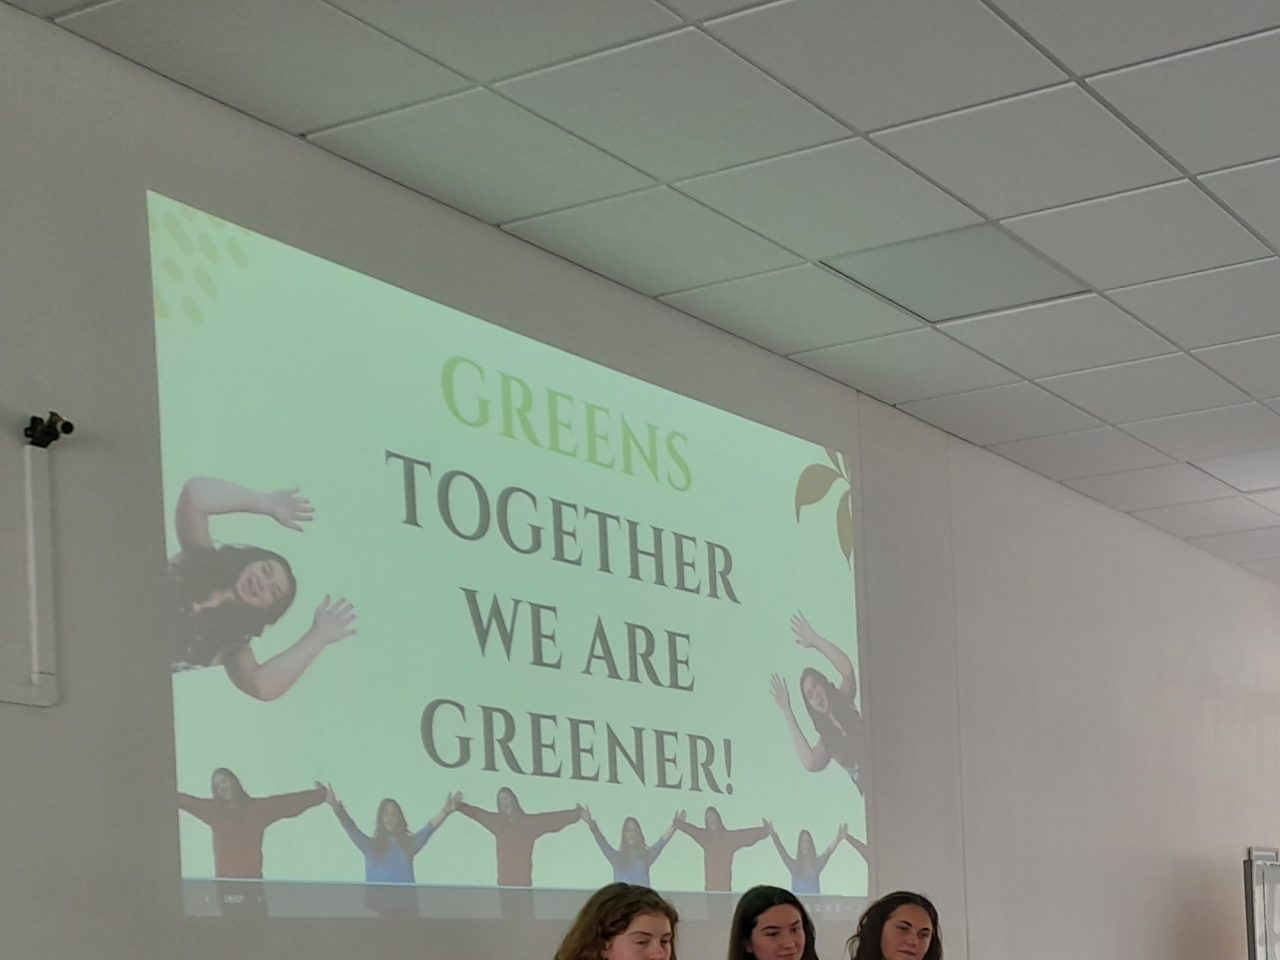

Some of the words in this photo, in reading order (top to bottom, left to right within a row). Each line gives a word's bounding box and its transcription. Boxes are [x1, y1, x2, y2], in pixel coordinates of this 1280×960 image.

[441, 356, 693, 492] GREENS
[384, 449, 742, 604] TOGETHER
[458, 586, 563, 670] WE
[580, 615, 696, 692] ARE
[420, 698, 735, 796] GREENER!
